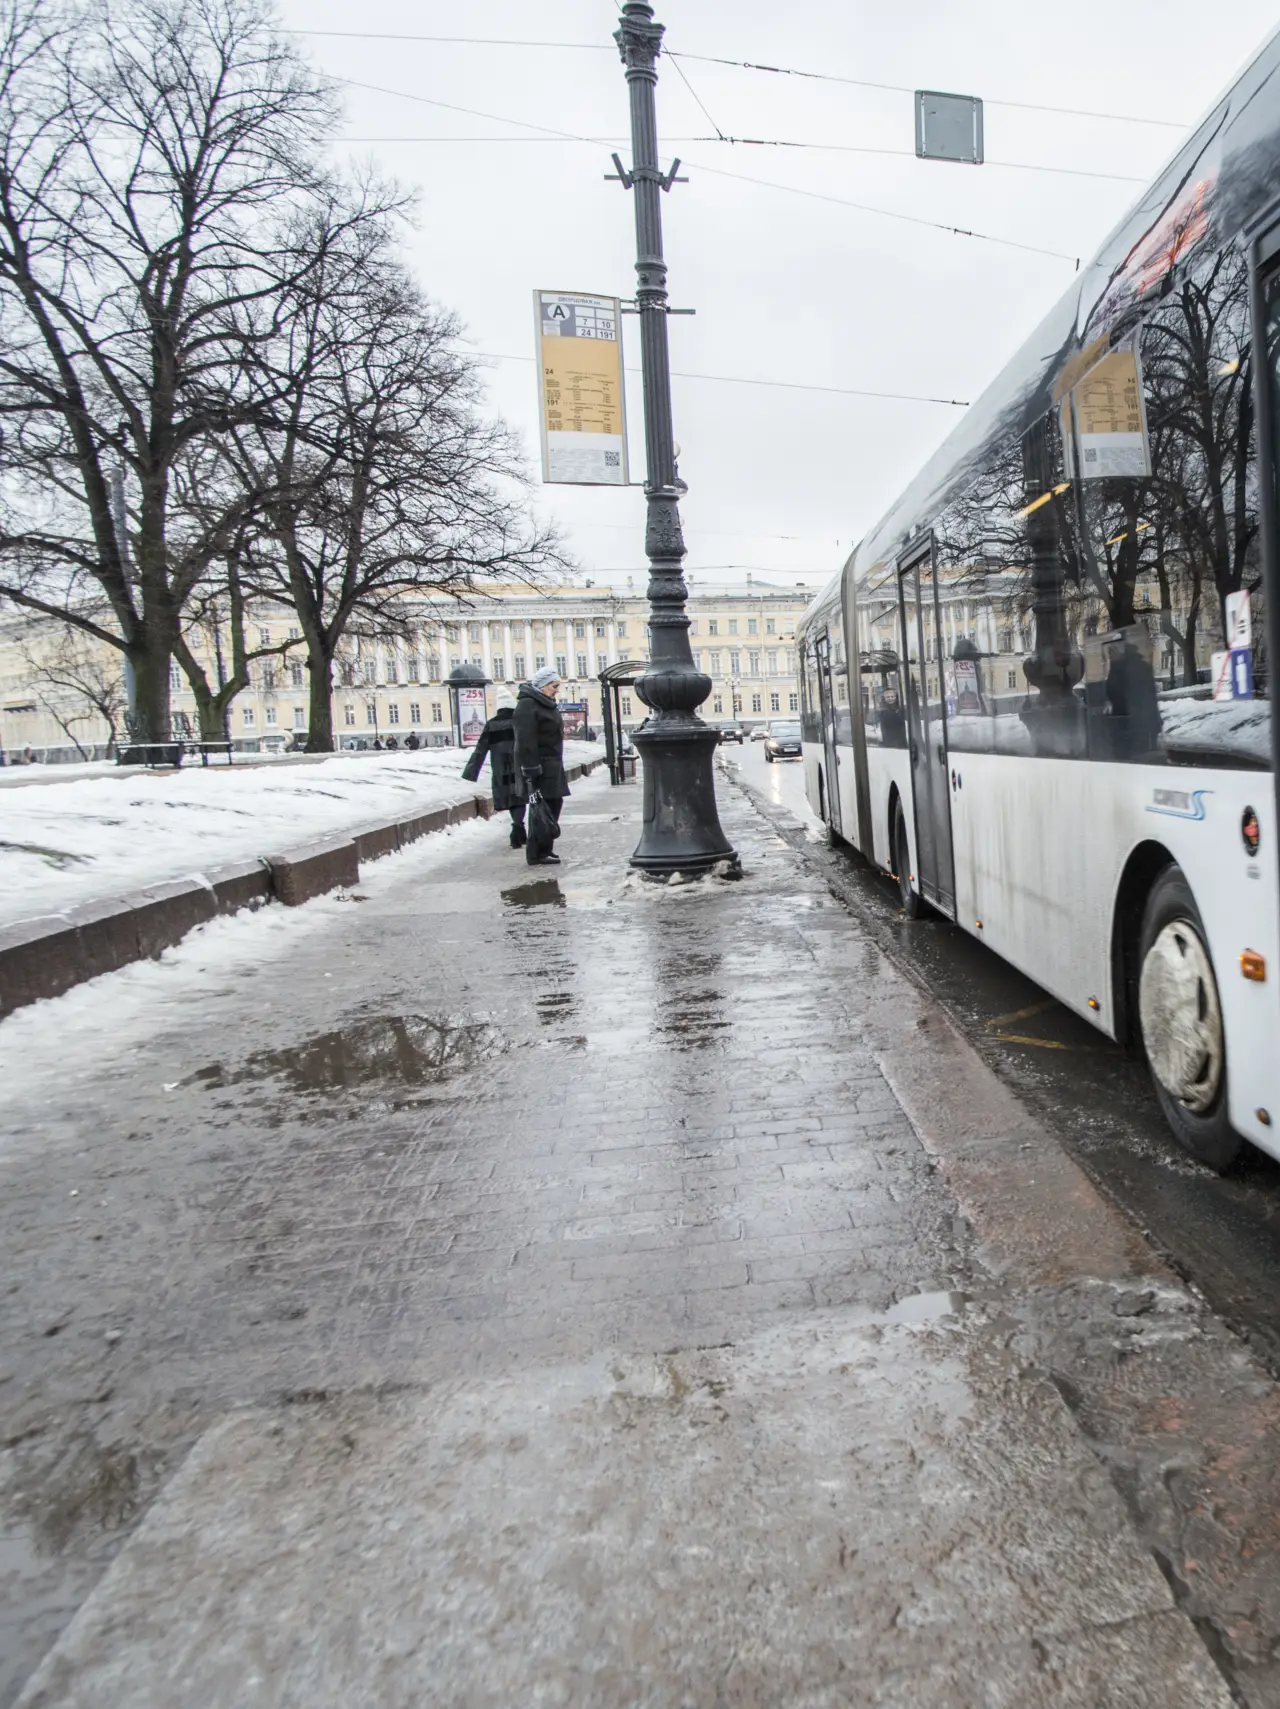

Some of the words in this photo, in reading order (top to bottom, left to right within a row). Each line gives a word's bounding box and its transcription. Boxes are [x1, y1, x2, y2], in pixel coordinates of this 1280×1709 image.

[601, 321, 611, 329] 10
[581, 328, 591, 336] 24
[599, 331, 613, 339] 191
